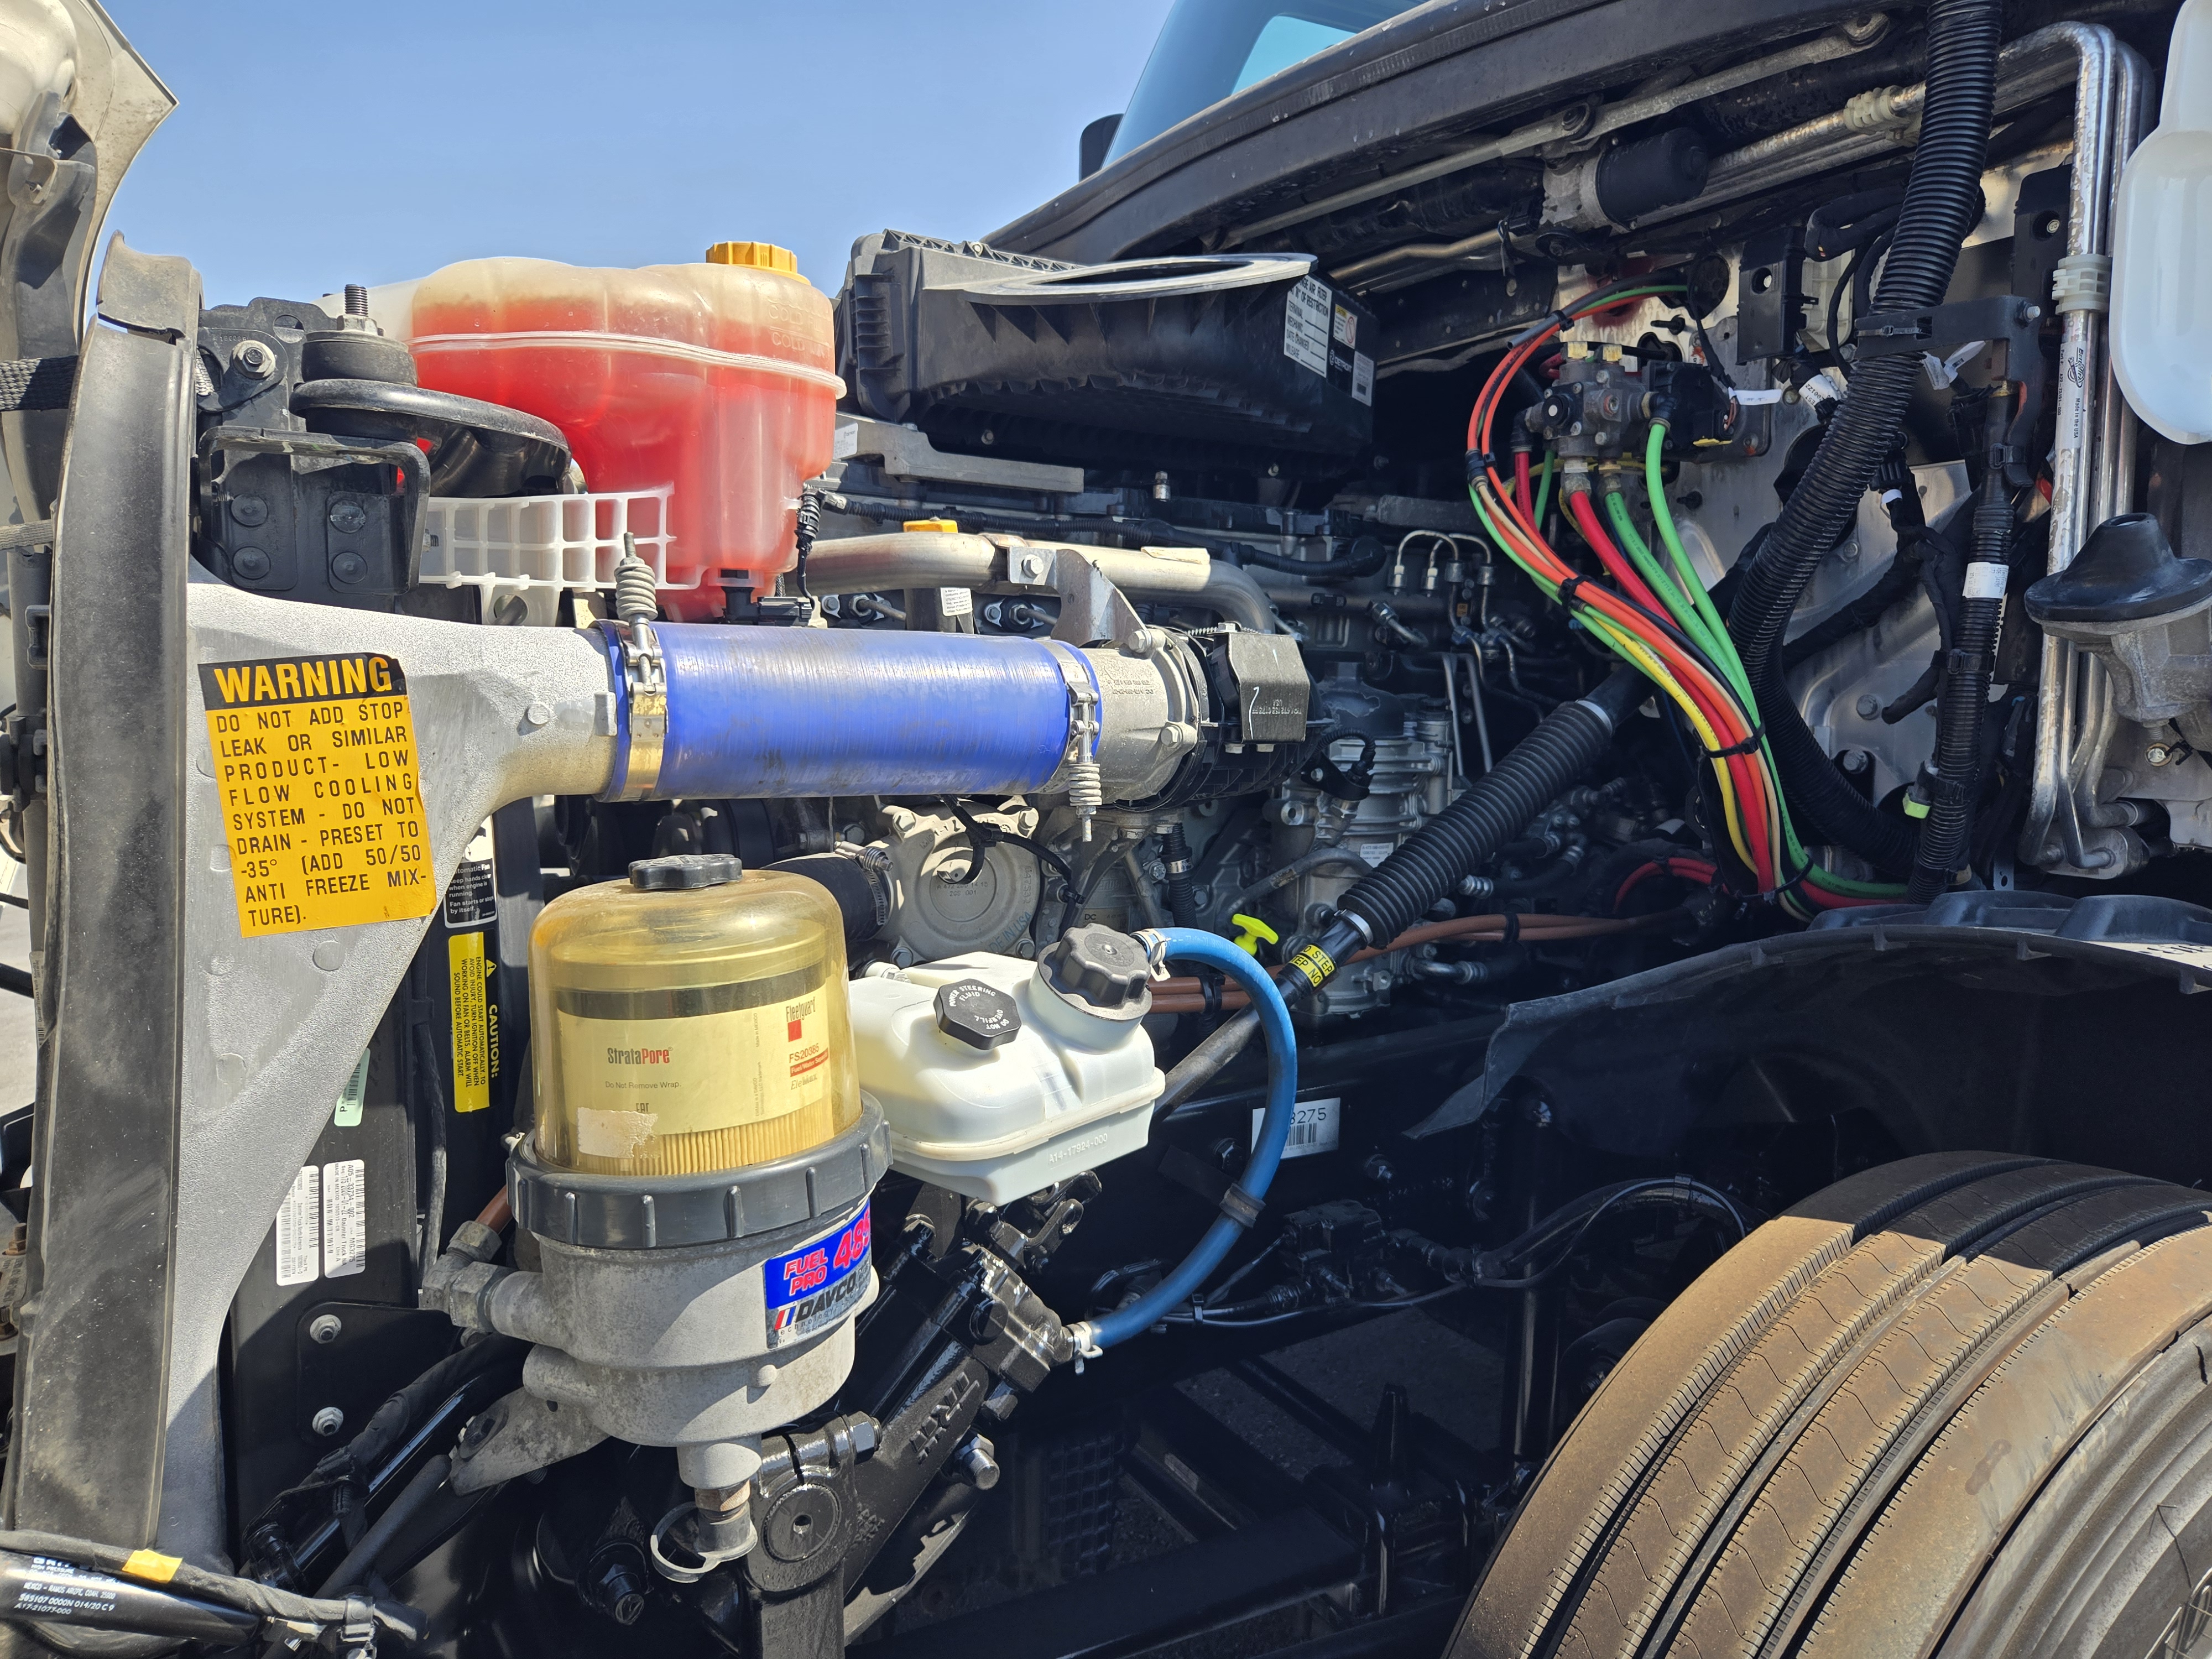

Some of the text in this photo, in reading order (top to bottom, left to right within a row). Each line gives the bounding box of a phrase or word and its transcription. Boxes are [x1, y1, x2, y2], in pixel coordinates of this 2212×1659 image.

[769, 305, 802, 325] COLD
[772, 332, 805, 351] COLD
[213, 656, 392, 703] WARNING
[217, 701, 403, 733] DO NOT ADD STOP
[221, 726, 408, 758] LEAK OR SIMILAR
[365, 749, 409, 769] LOW
[229, 773, 412, 806] FLOW COOLING
[233, 808, 305, 831] SYSTEM
[343, 801, 365, 820] DO
[382, 797, 415, 816] NOT
[237, 833, 291, 855] DRAIN
[320, 825, 383, 846] PRESET
[397, 821, 419, 838] TO
[366, 844, 421, 865] 50/50
[246, 868, 426, 902] ANTI FREEZE MIX-
[1003, 928, 1015, 942] IN
[1013, 911, 1031, 933] USA
[1291, 956, 1321, 984] TEP NO
[1312, 951, 1333, 972] STEP
[462, 992, 468, 1003] ON
[949, 985, 996, 1006] POWER STEERING
[959, 992, 980, 1001] FLUID
[786, 997, 816, 1022] Fleetguard
[974, 1009, 1004, 1024] OVERFILL
[463, 1019, 469, 1029] OR
[489, 1004, 499, 1078] CAUTION:
[789, 1043, 820, 1063] FS20385
[480, 1075, 486, 1085] TO
[1050, 1133, 1107, 1163] A14-17924-000
[784, 1248, 828, 1280] FUEL
[789, 1265, 827, 1296] PRO
[795, 1271, 857, 1323] DAVCO
[23, 1582, 43, 1590] MEXICO
[48, 1585, 65, 1594] RAMOS
